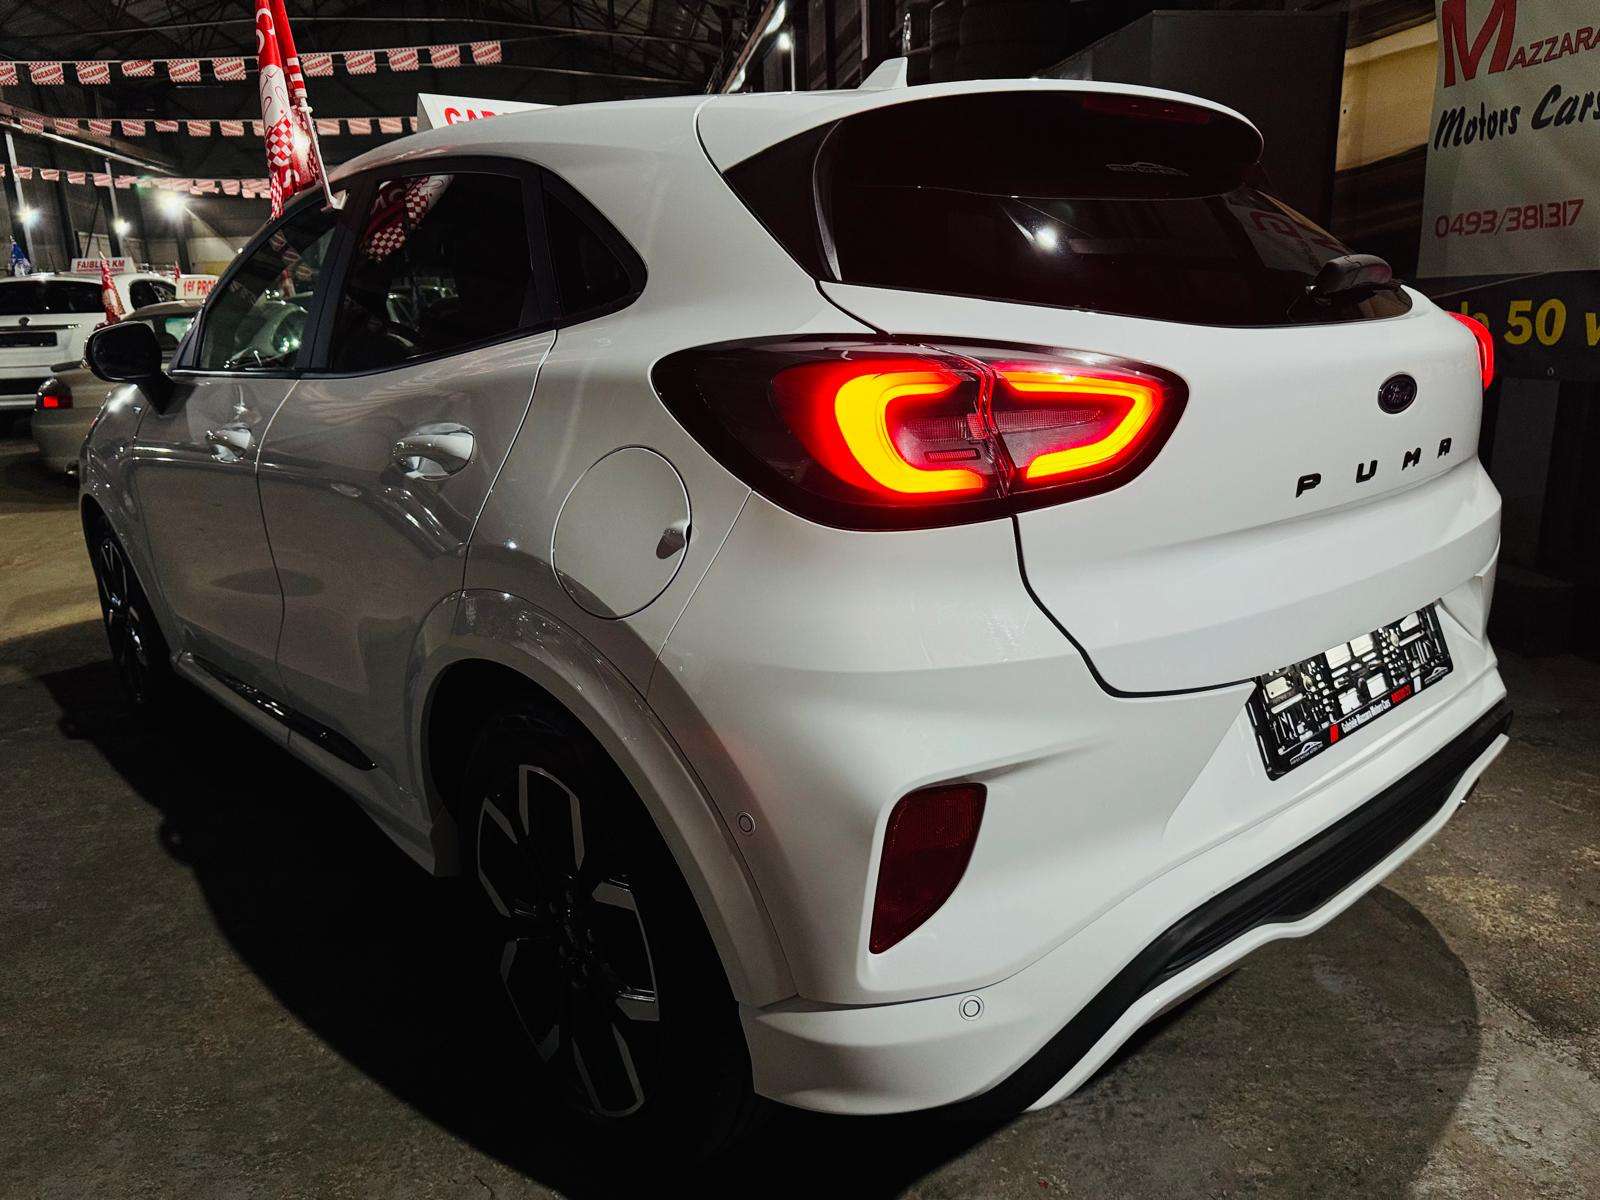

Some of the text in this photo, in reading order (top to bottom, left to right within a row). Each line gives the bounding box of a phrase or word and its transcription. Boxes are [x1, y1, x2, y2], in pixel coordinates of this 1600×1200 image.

[32, 66, 61, 80] OCCASION
[79, 66, 107, 80] OCCASION
[170, 63, 198, 77] OCCASION
[216, 62, 243, 76] OCCASION
[1434, 102, 1521, 150] Motors
[76, 260, 125, 269] FAIBLS KM
[1503, 298, 1567, 347] 50
[1296, 437, 1452, 498] PUMA
